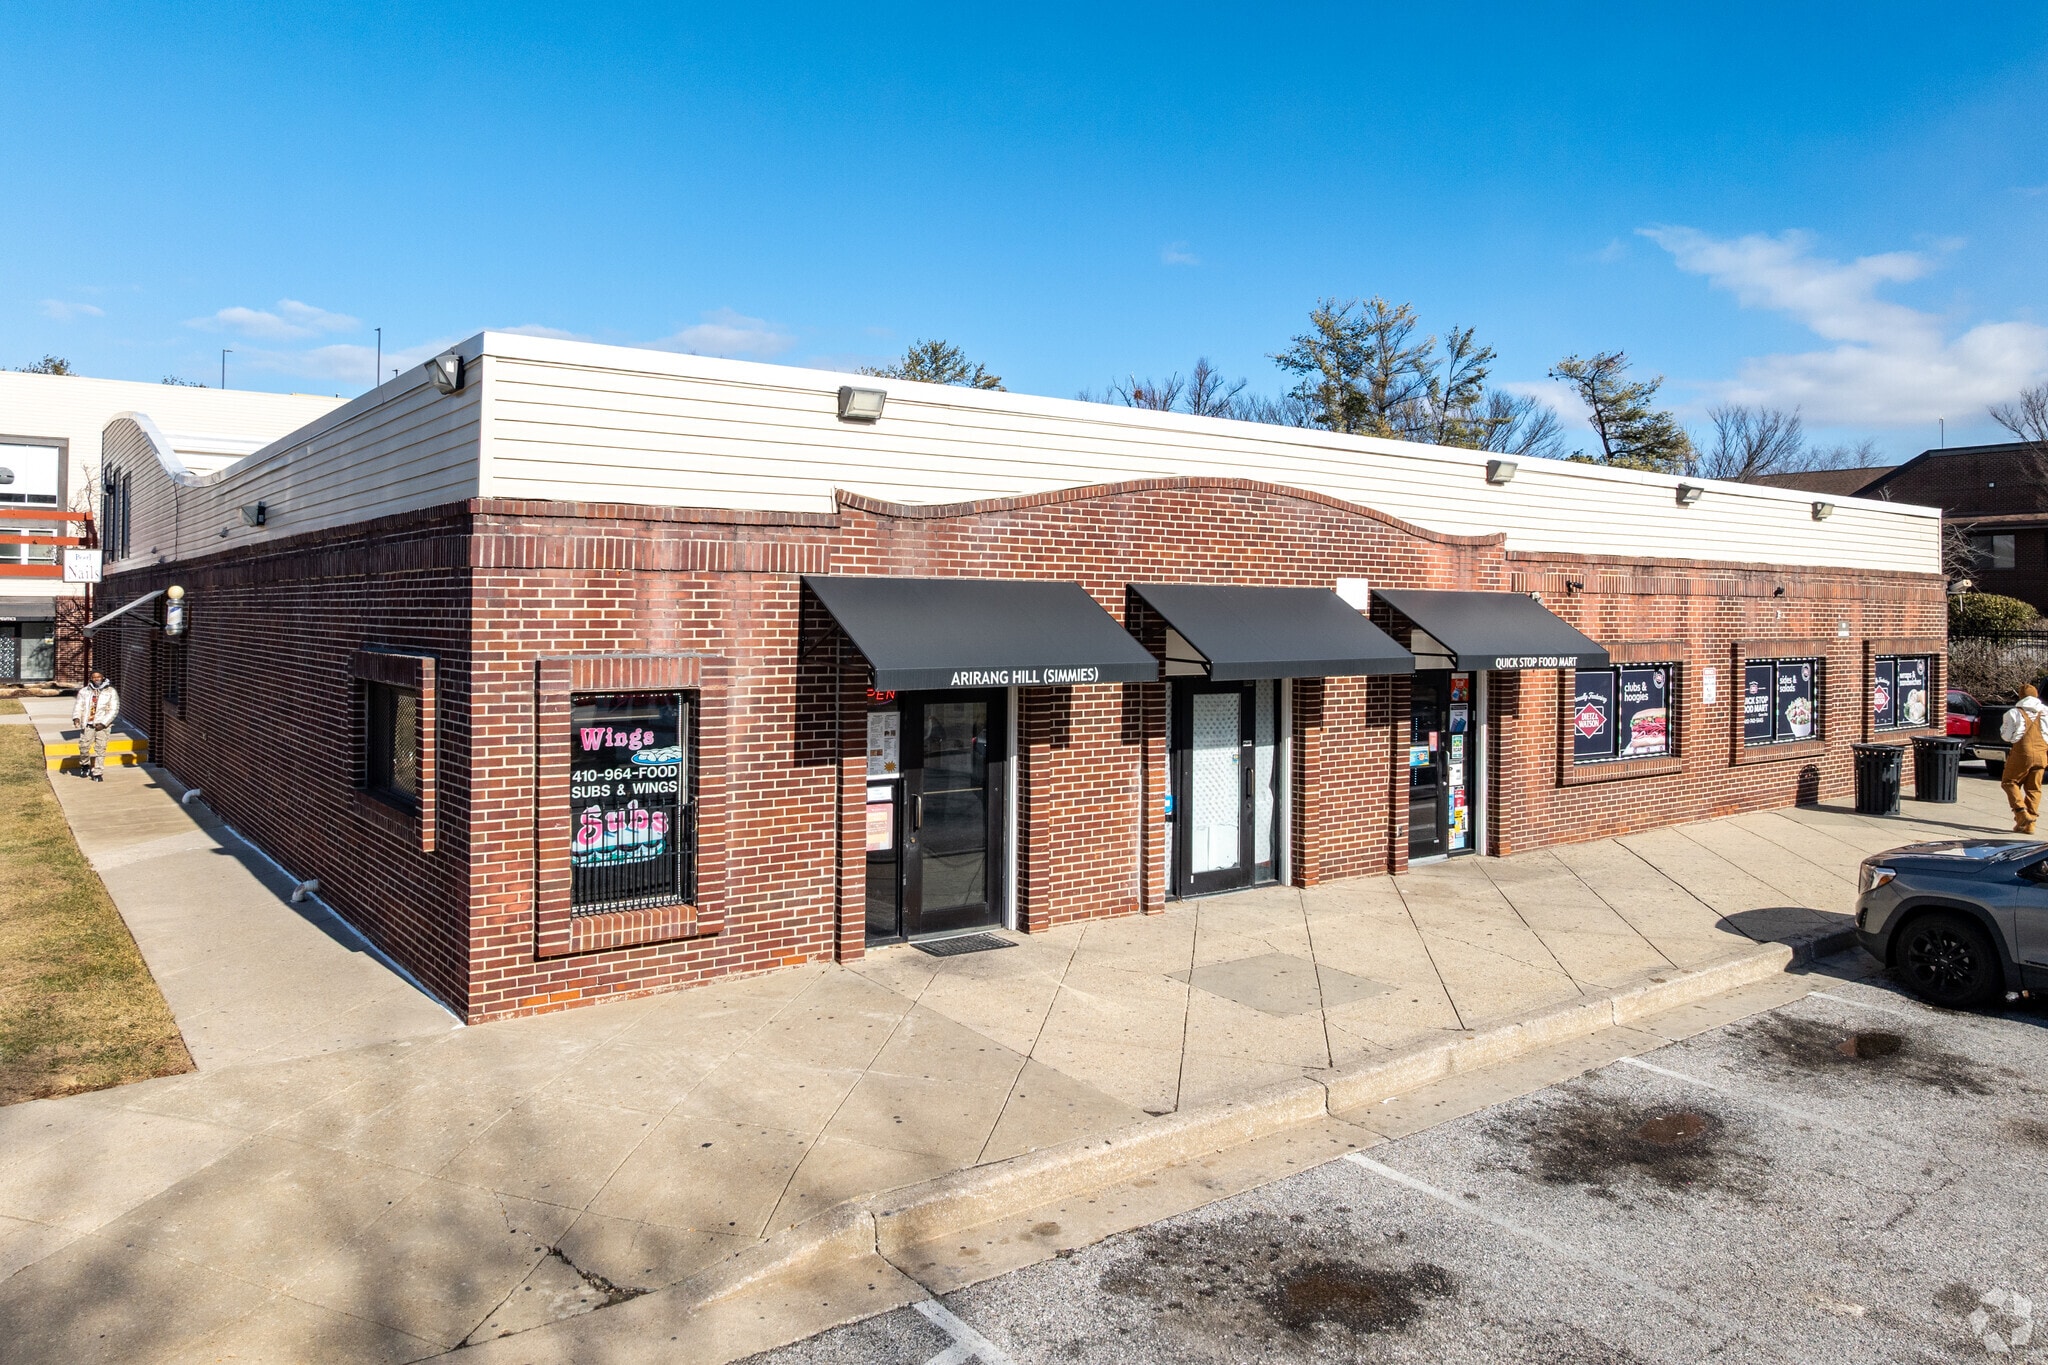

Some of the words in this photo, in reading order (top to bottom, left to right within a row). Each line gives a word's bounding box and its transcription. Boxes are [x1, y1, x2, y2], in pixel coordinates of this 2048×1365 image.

[69, 565, 99, 579] Nails
[1495, 657, 1518, 669] QUICK
[1519, 657, 1537, 667] STOP
[1538, 656, 1558, 667] FOOD
[1558, 656, 1578, 667] MART
[951, 670, 1009, 686] ARIRANG
[1012, 669, 1040, 684] HILL
[1043, 667, 1099, 684] (SIMMIES)
[866, 687, 896, 700] PEN
[1641, 681, 1648, 691] &
[1624, 691, 1649, 704] hoagies
[580, 727, 655, 751] Wings
[572, 765, 678, 783] 410-964-FOOD
[571, 784, 611, 799] SUBS
[617, 783, 626, 796] &
[633, 780, 678, 795] WINGS
[576, 798, 670, 847] Subs
